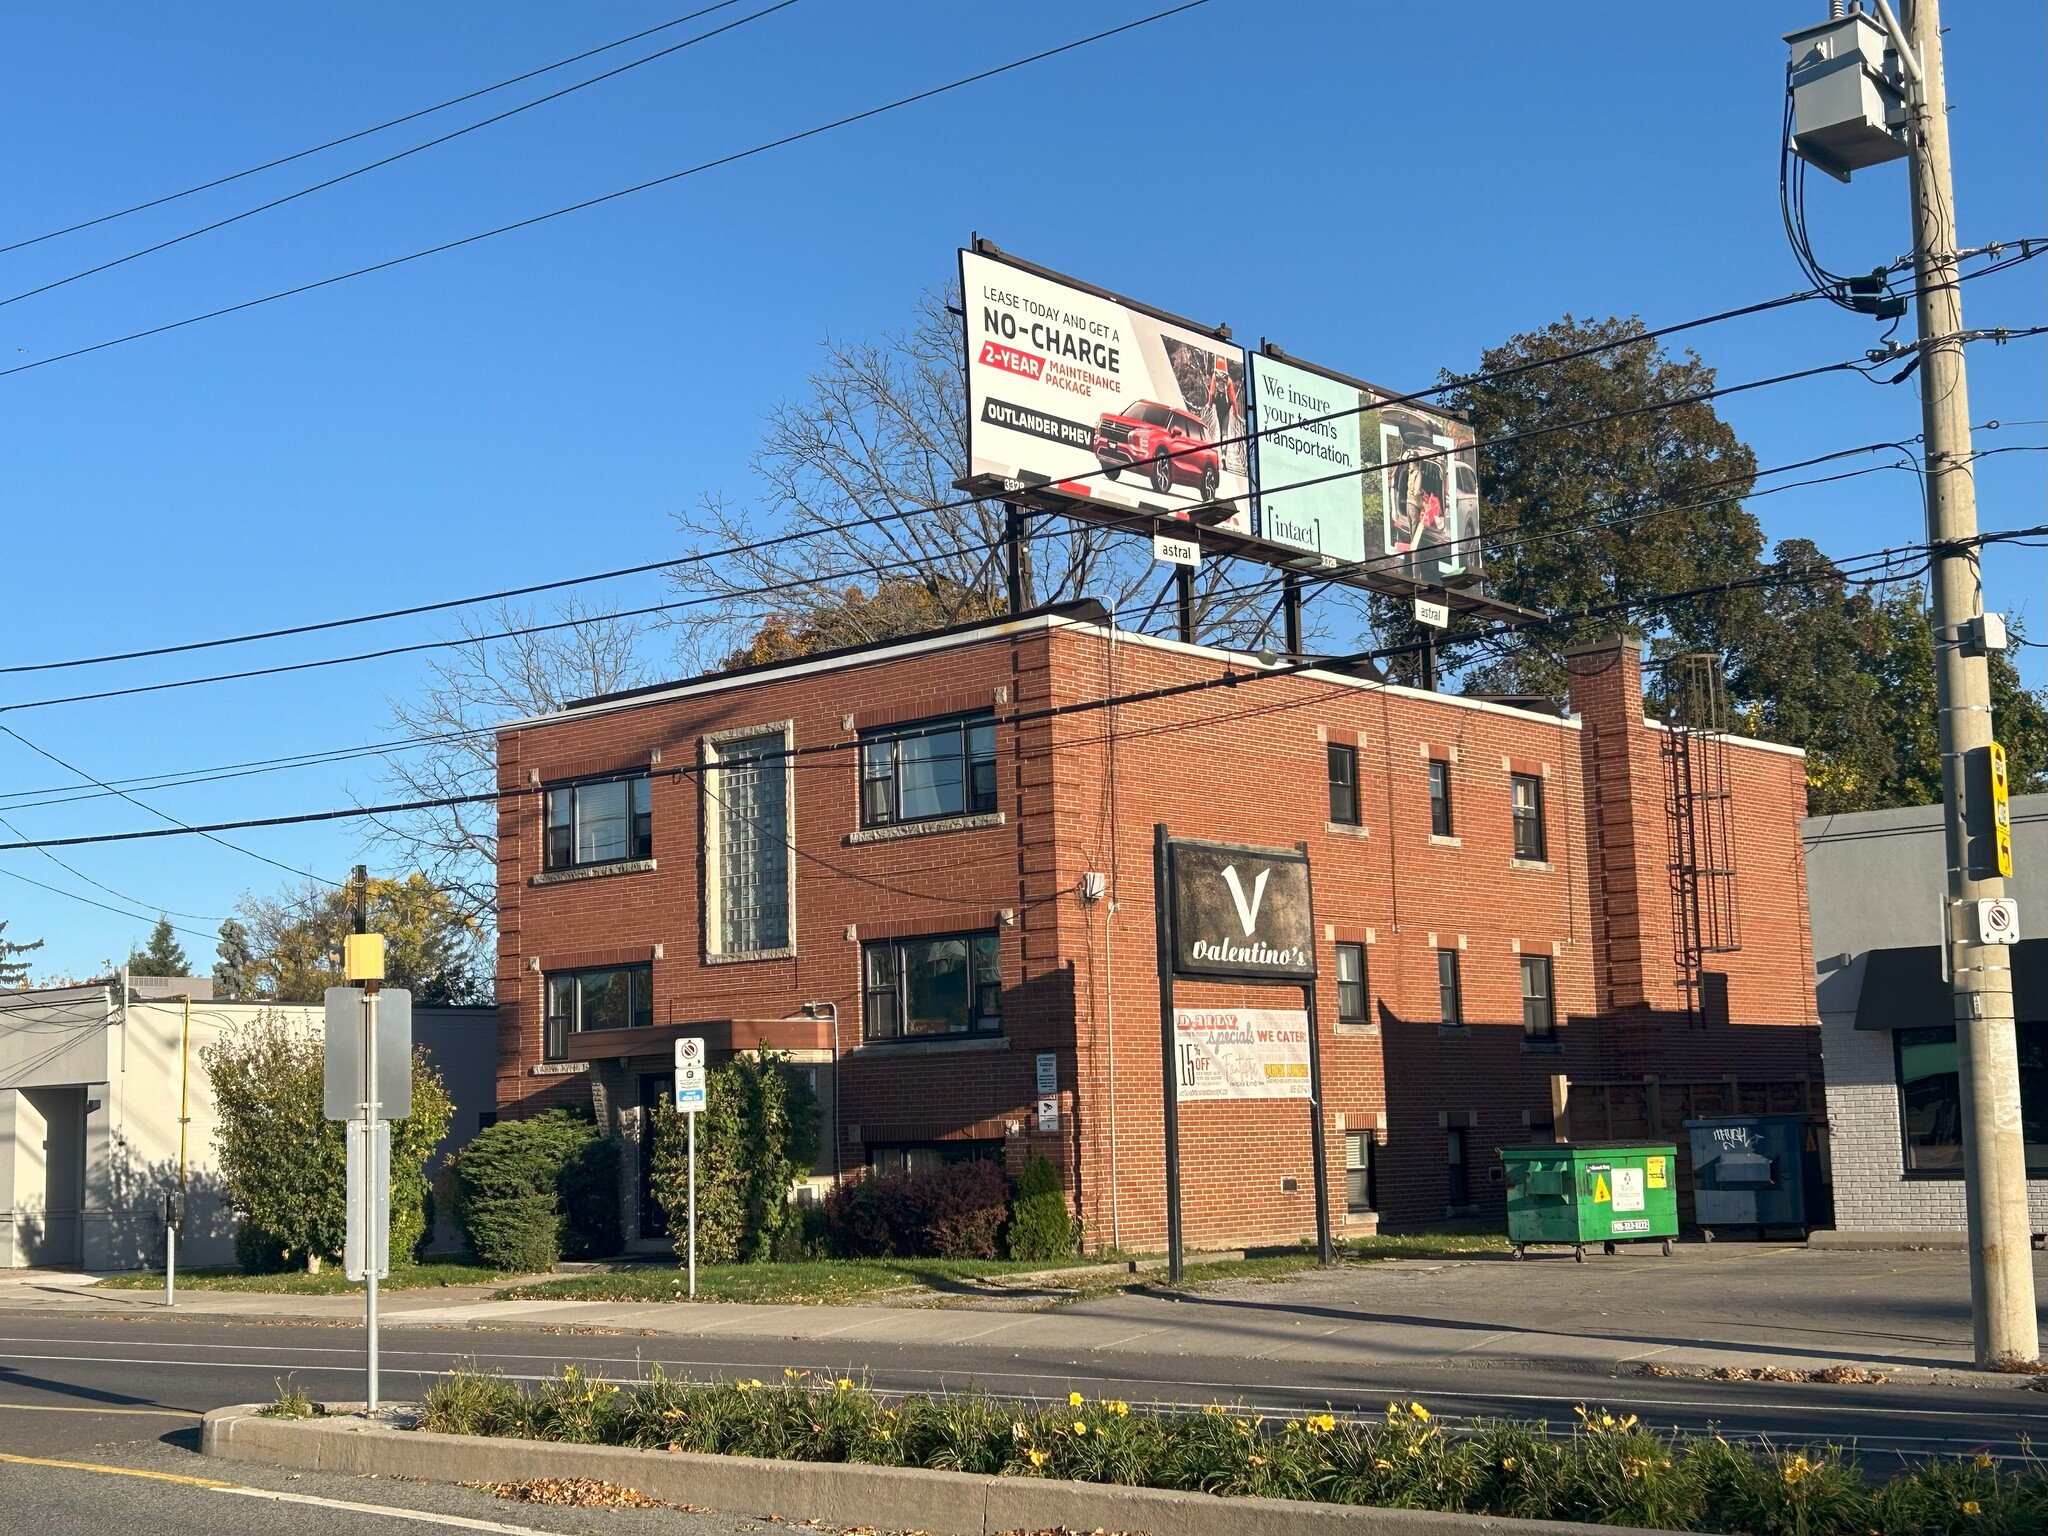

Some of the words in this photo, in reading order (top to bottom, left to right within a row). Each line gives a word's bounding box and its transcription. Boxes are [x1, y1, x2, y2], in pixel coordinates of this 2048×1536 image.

[983, 285, 1020, 309] LEASE
[1022, 298, 1060, 321] TODAY
[1062, 312, 1086, 330] AND
[1089, 321, 1110, 338] GET
[1112, 329, 1120, 342] A
[983, 305, 1120, 374] NO-CHARGE
[984, 345, 1040, 377] 2-YEAR
[1049, 360, 1121, 393] MAINTENANCE
[1045, 373, 1092, 397] PACKAGE
[1262, 374, 1285, 400] We
[1288, 384, 1331, 414] insure
[987, 403, 1059, 437] OUTLANDER
[1061, 424, 1092, 446] PHEV
[1263, 404, 1294, 427] your
[1297, 412, 1338, 440] team's
[1264, 425, 1353, 468] transportation.
[1162, 544, 1192, 560] astral
[1420, 607, 1441, 622] astral
[1221, 864, 1271, 937] V
[1192, 936, 1307, 967] Valentino's
[1177, 1014, 1238, 1031] DAILY
[1206, 1021, 1255, 1056] specials
[1257, 1030, 1275, 1043] WE
[1195, 1057, 1211, 1071] OFF
